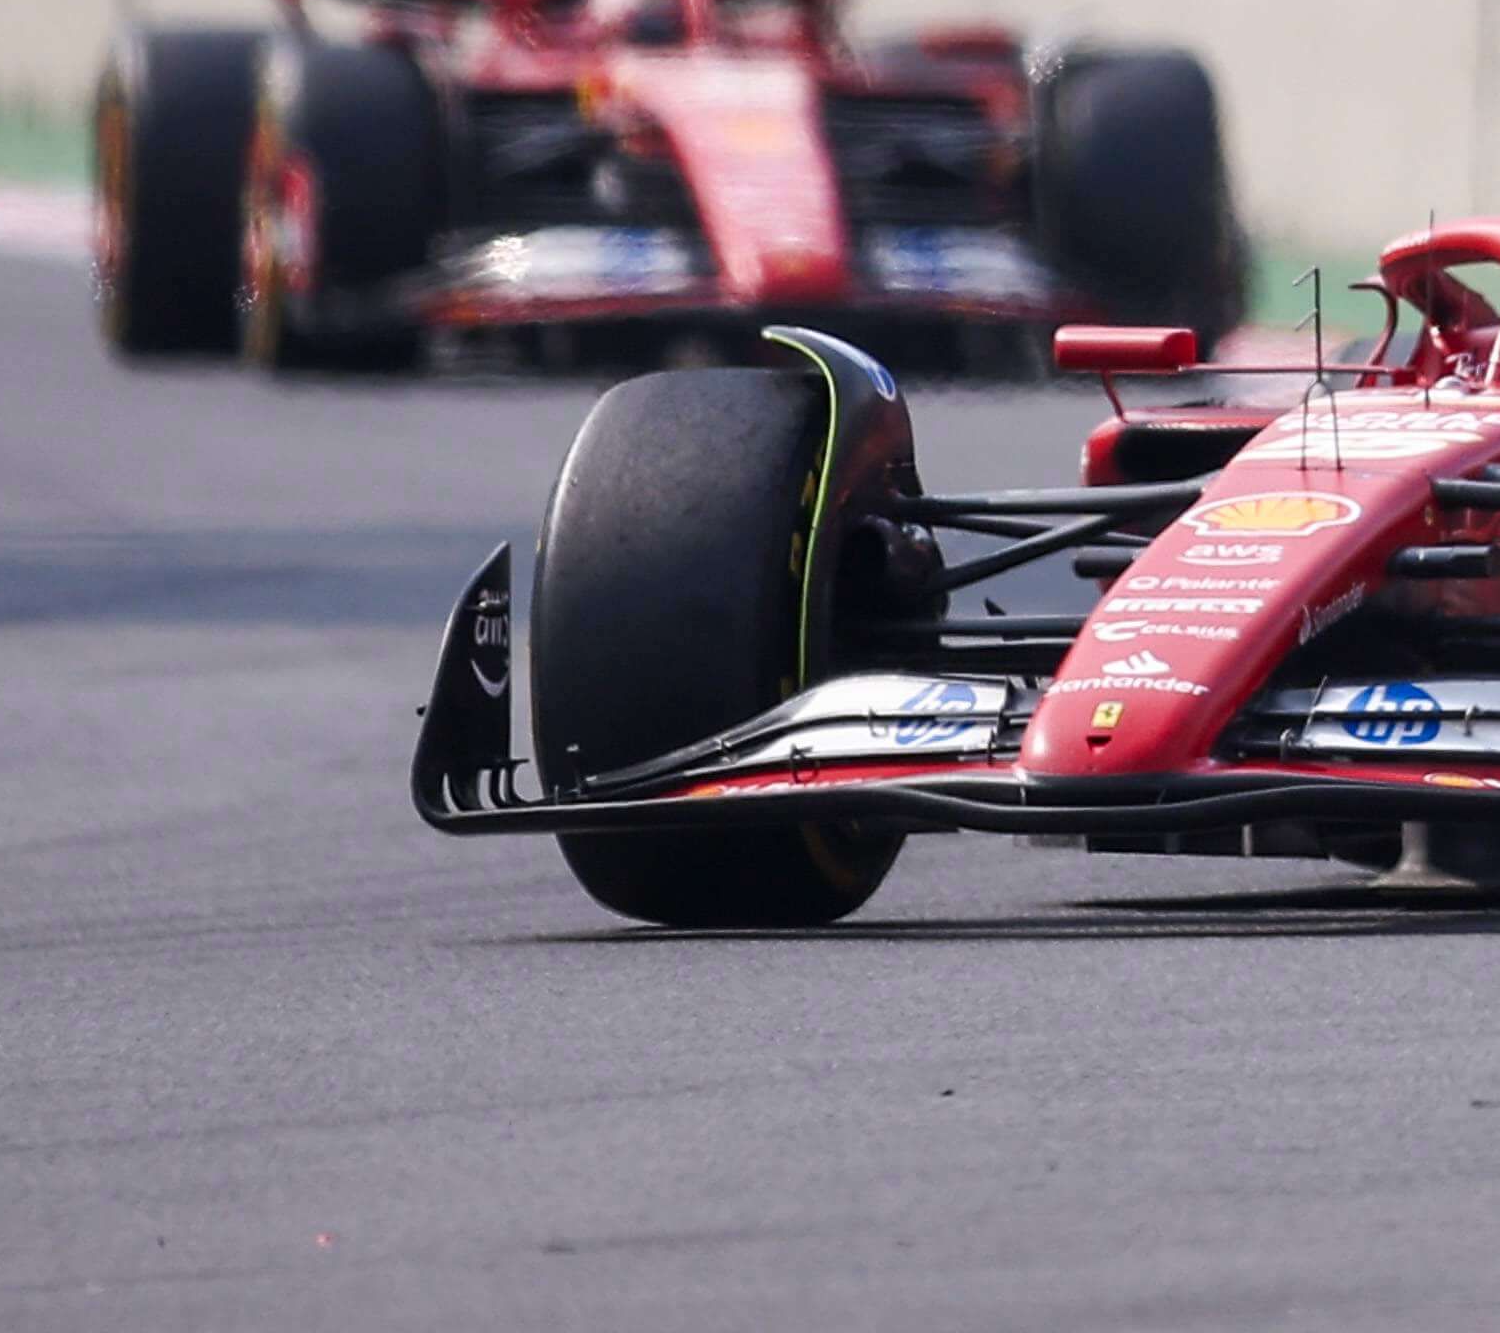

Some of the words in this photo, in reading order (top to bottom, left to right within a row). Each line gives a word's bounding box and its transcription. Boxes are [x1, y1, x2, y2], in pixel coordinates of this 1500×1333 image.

[1181, 543, 1285, 561] aws
[899, 683, 974, 745] hp
[1352, 685, 1437, 745] hp
